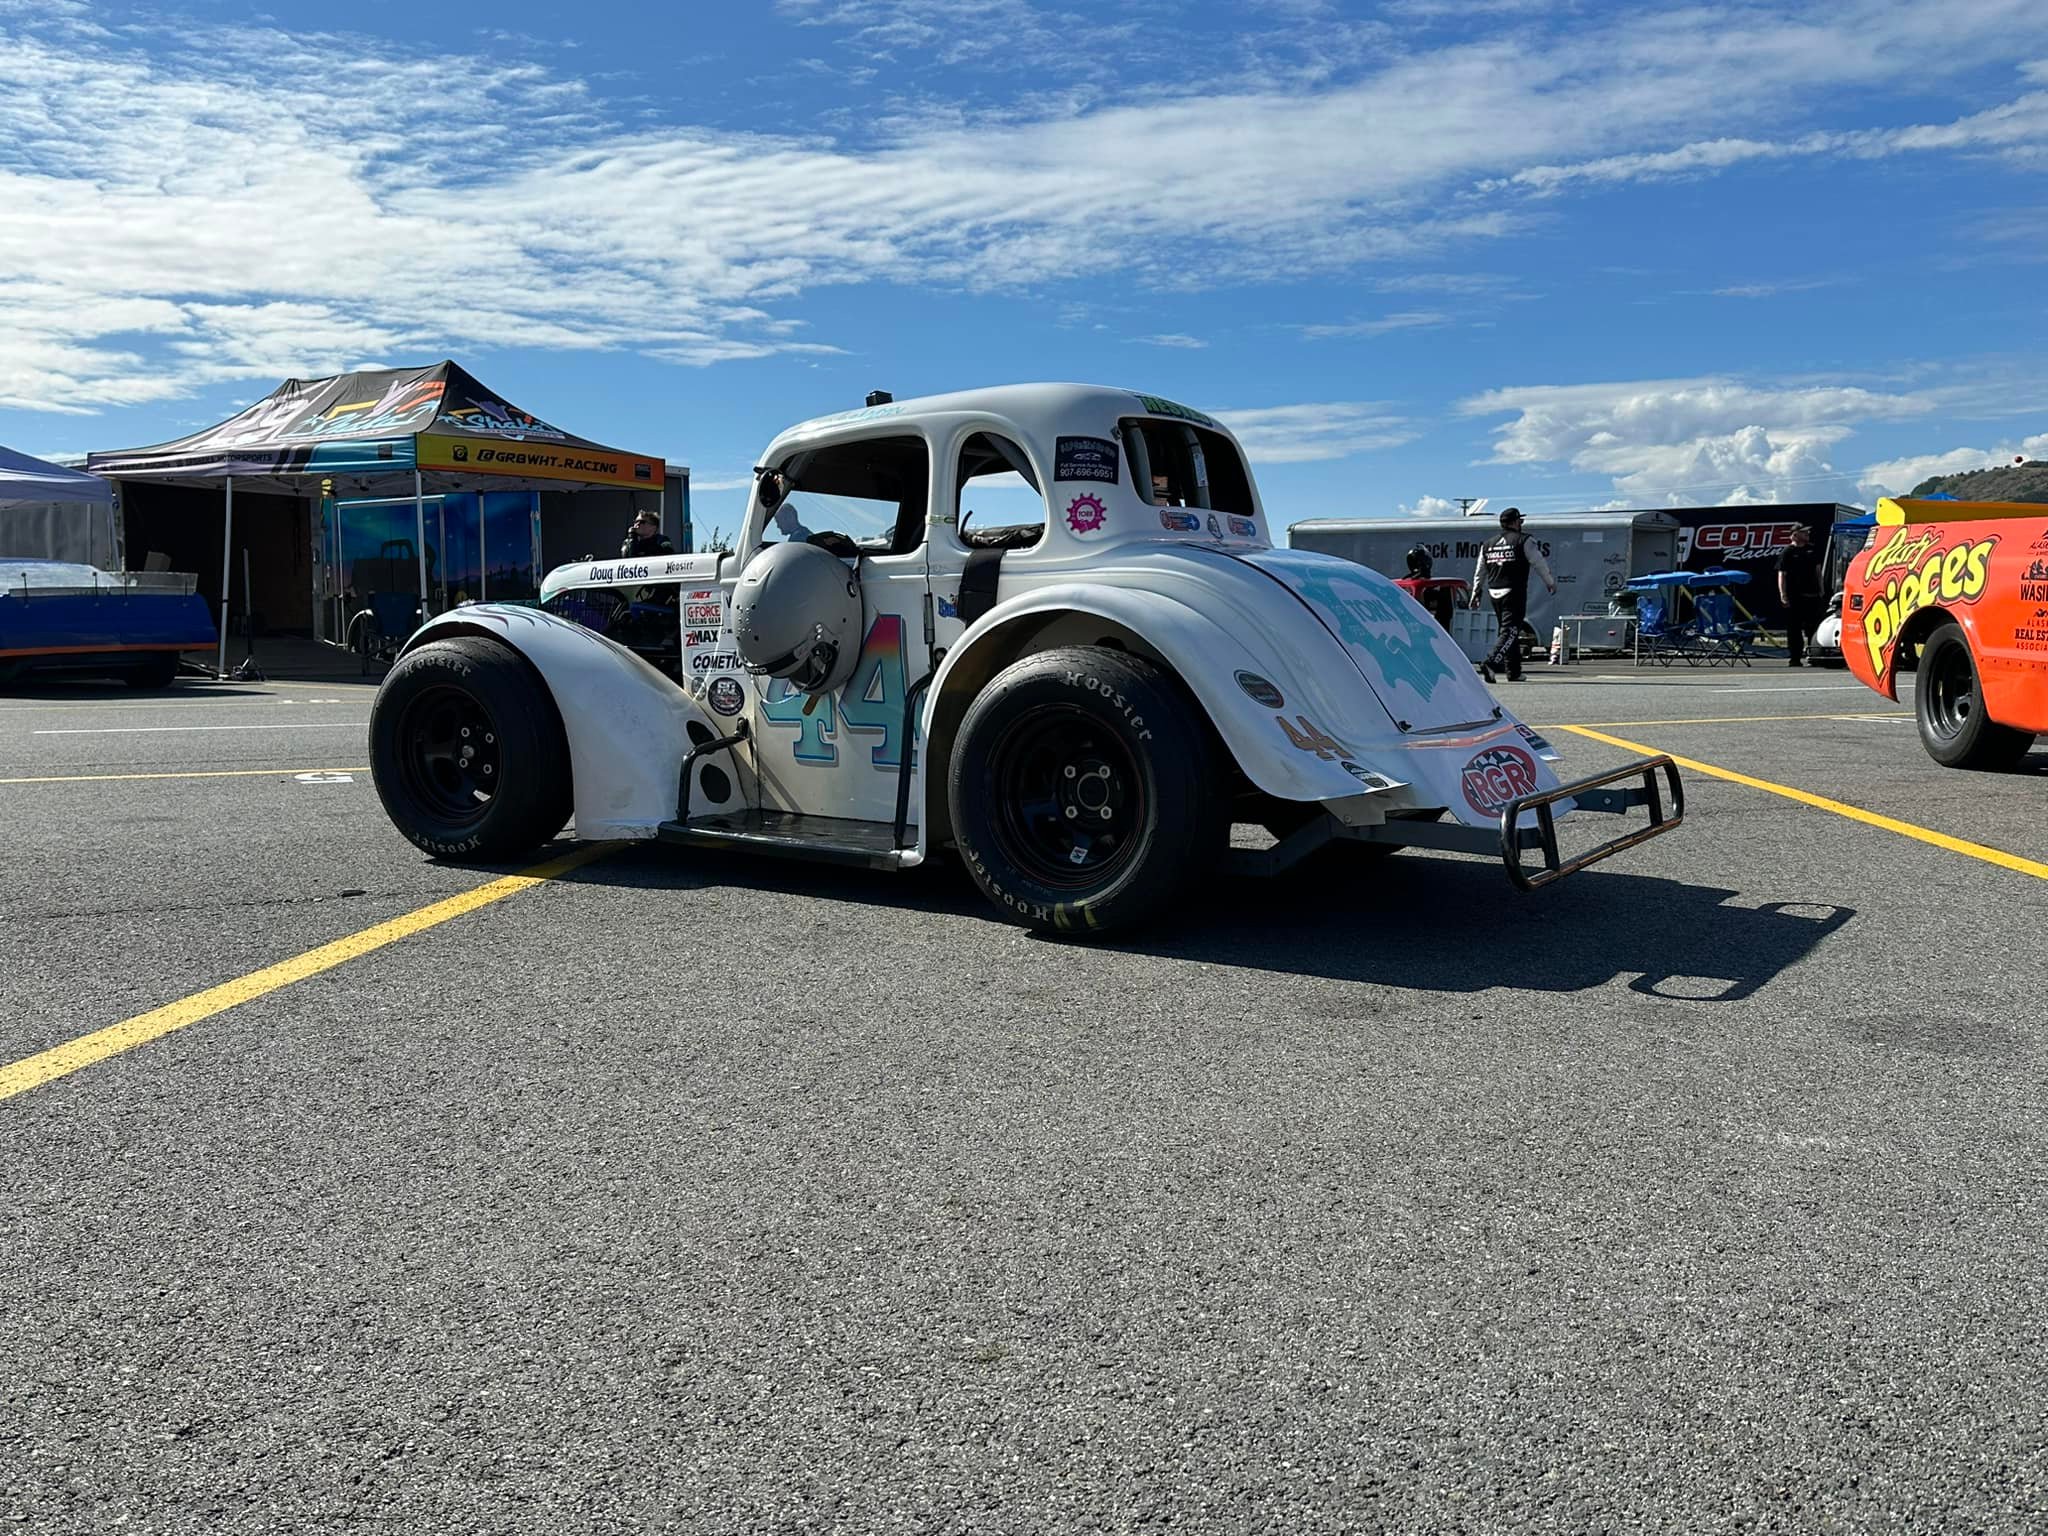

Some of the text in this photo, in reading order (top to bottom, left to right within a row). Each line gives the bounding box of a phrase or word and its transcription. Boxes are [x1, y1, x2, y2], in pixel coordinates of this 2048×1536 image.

[1060, 468, 1113, 479] 907-696-6951
[1696, 525, 1792, 549] COTE
[1723, 546, 1784, 562] Racin
[590, 566, 613, 583] Doug
[665, 561, 694, 574] Hoosier
[687, 617, 707, 625] RACING
[2015, 628, 2034, 640] REAL
[404, 656, 472, 679] Hoosier
[1060, 670, 1153, 741] Hoosier
[1275, 715, 1356, 761] 44
[1463, 760, 1538, 808] RGR
